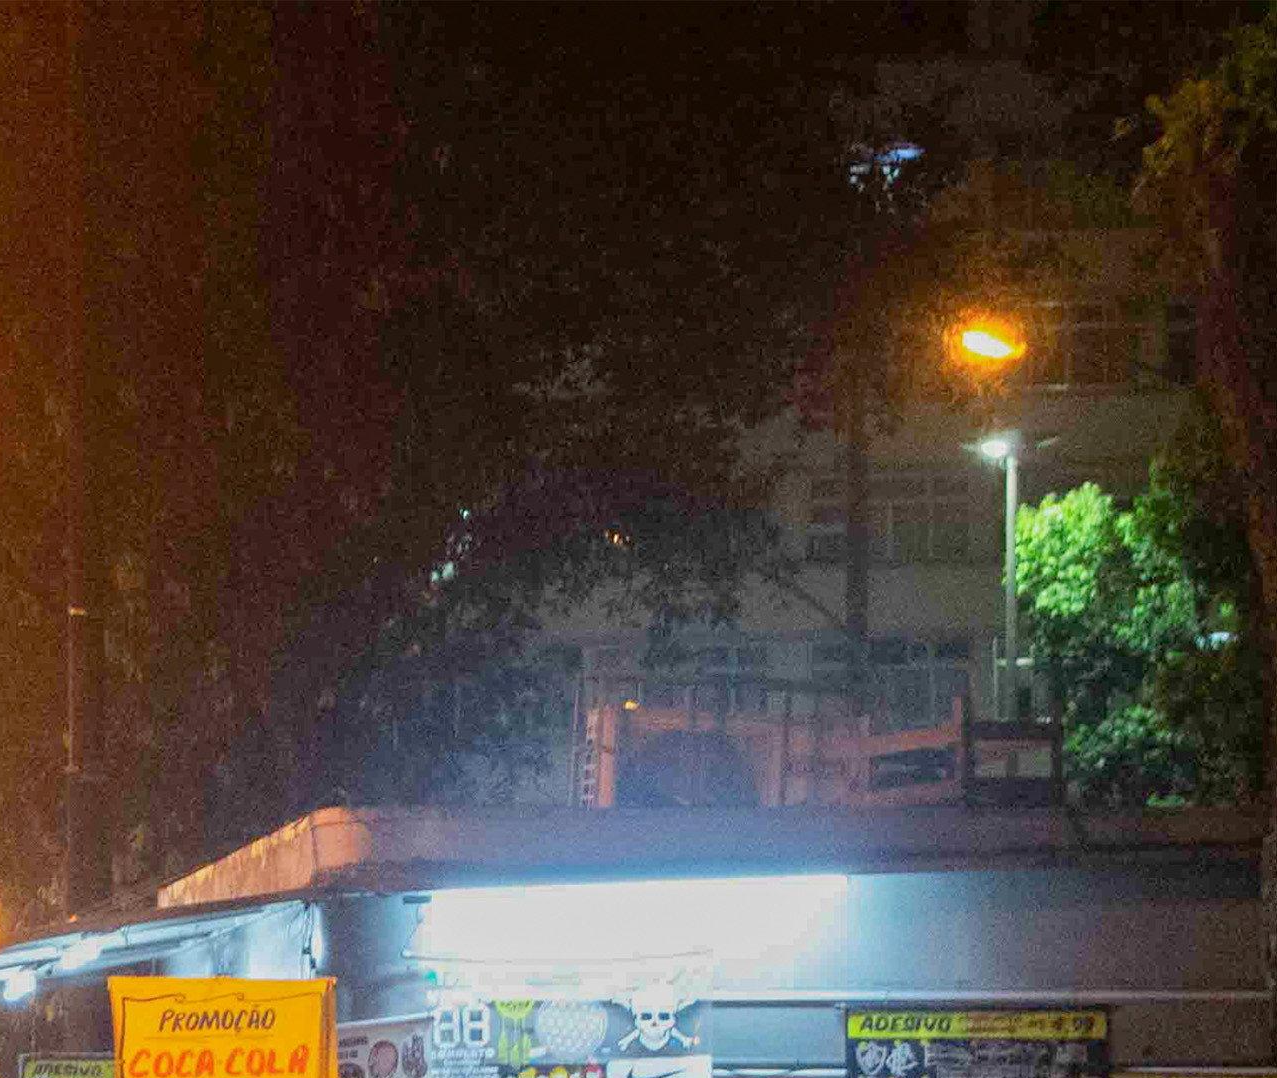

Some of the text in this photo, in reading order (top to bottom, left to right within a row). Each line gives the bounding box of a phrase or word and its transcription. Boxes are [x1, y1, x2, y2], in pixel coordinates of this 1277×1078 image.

[158, 1003, 276, 1034] PROMOÇÃO
[128, 1047, 215, 1078] COCA
[224, 1044, 309, 1077] COLA
